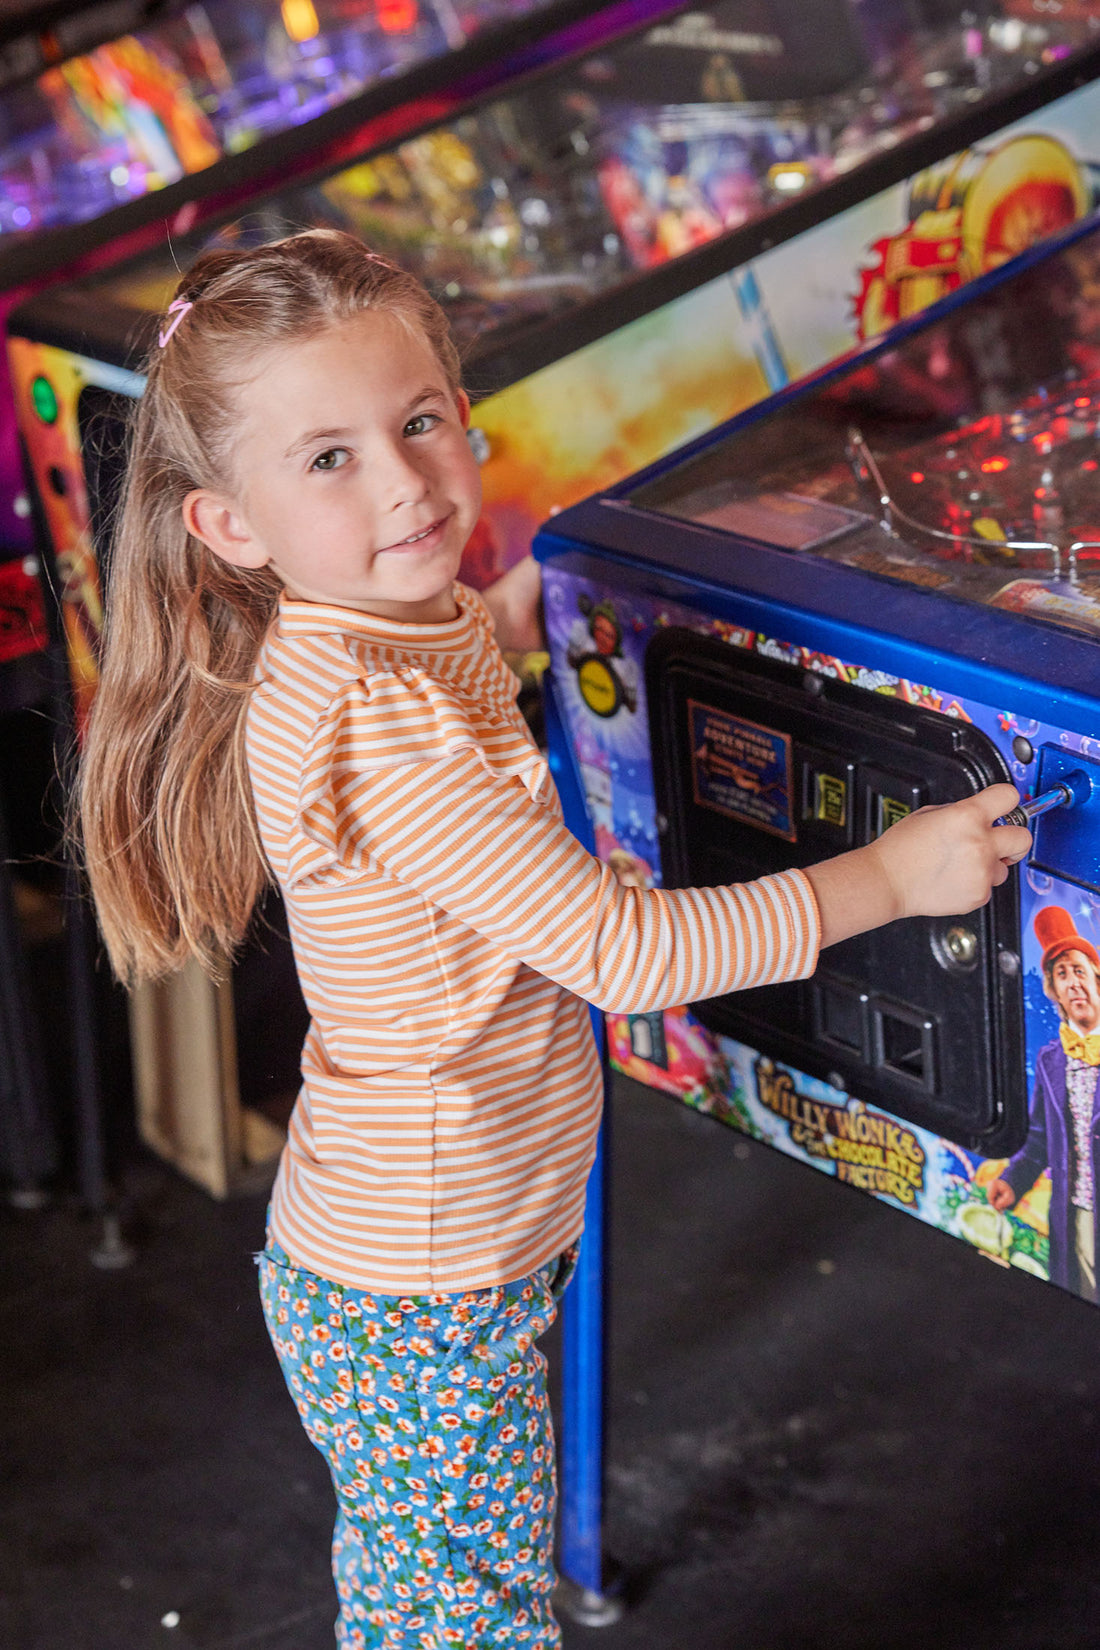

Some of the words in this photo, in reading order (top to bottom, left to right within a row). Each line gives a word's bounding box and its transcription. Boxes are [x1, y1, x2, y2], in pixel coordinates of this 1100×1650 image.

[758, 1058, 829, 1133] WILLY
[827, 1135, 922, 1188] CHOCOLATE
[838, 1160, 915, 1203] FACTORY
